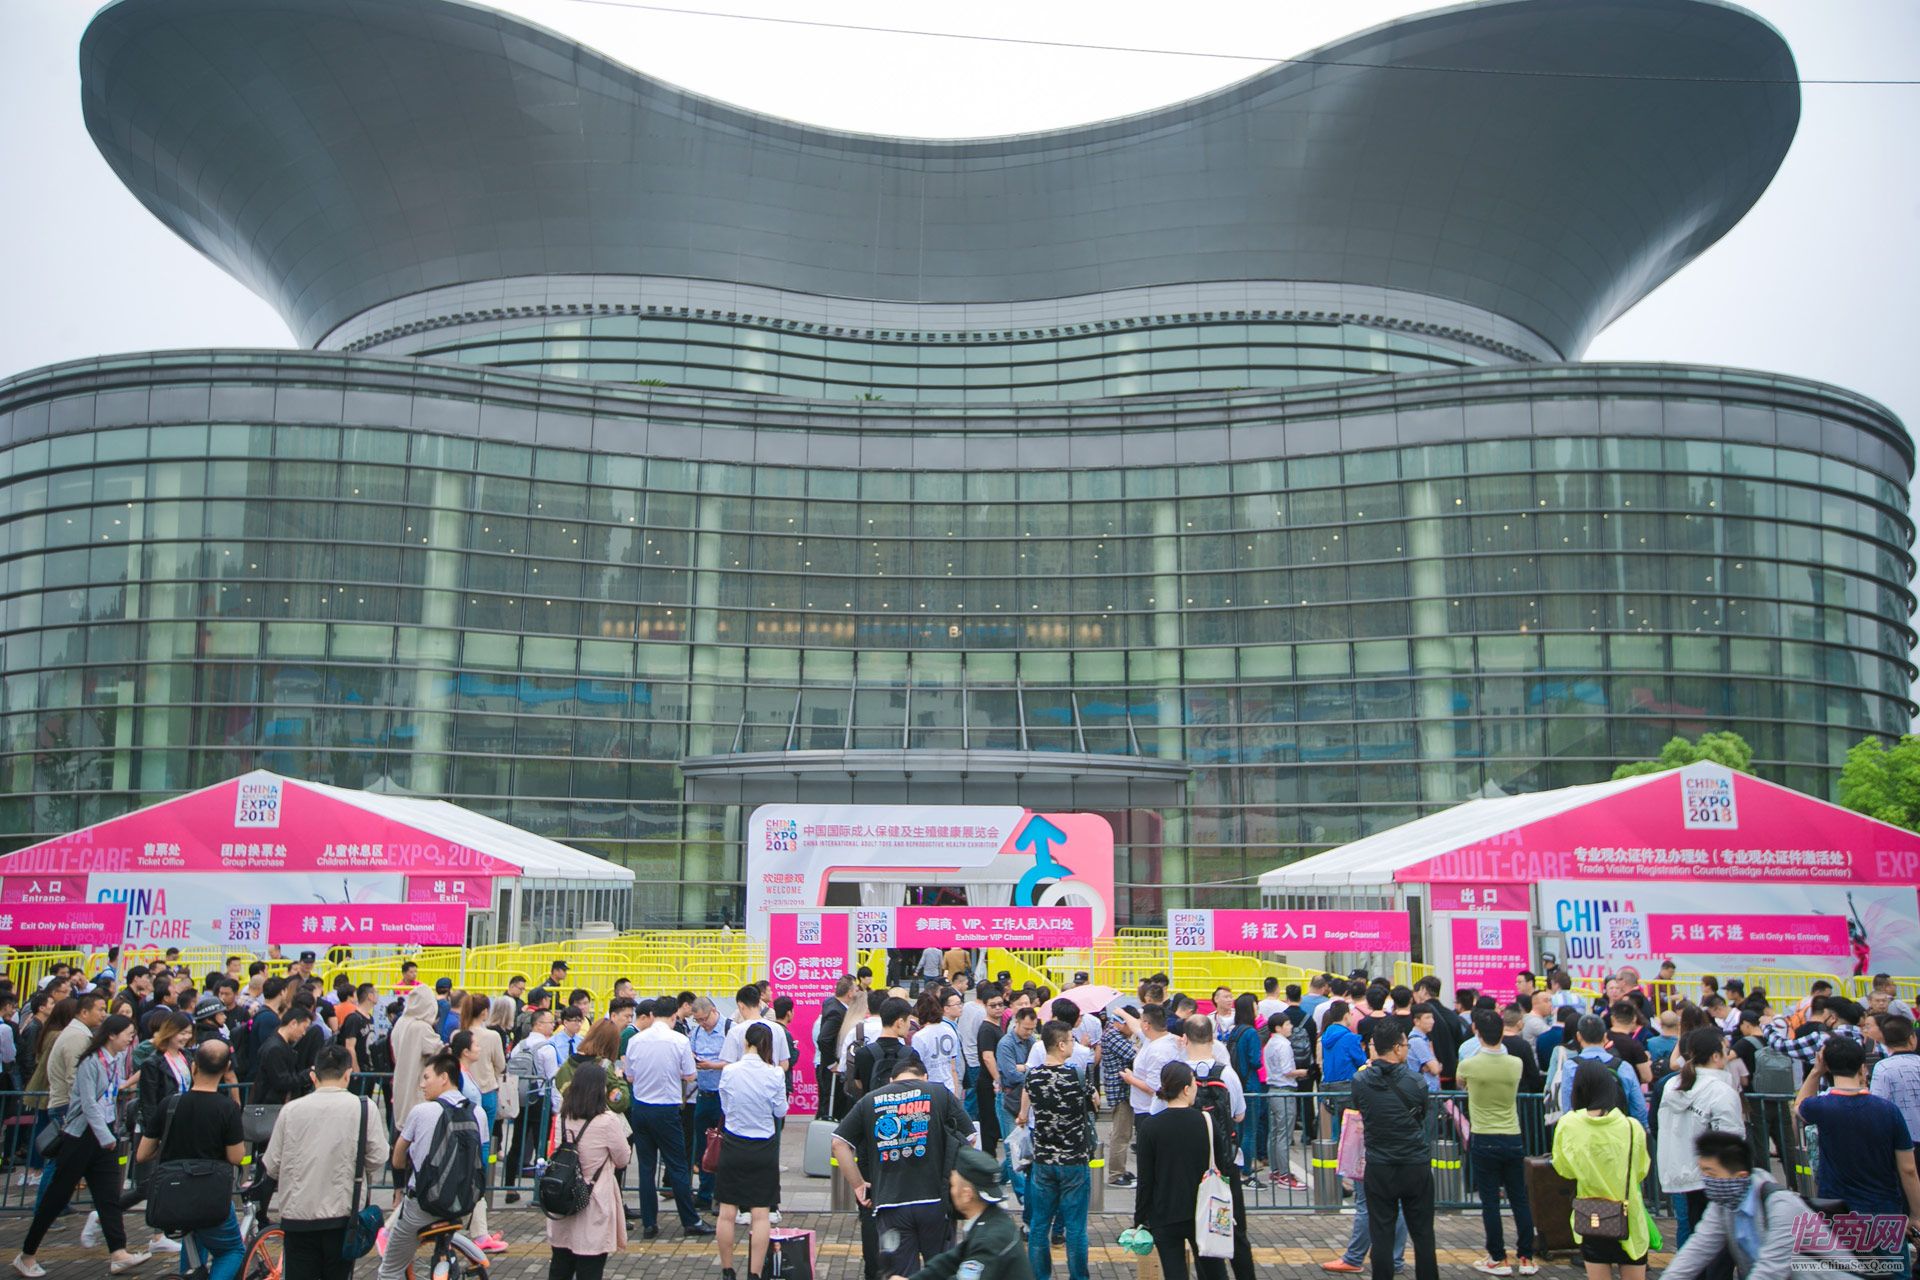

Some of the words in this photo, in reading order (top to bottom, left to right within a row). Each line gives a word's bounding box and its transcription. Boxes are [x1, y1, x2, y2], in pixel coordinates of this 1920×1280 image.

[242, 784, 277, 794] CHINA
[1686, 779, 1729, 789] CHINA
[241, 800, 277, 810] EXPO
[1688, 796, 1730, 808] EXPO
[239, 809, 275, 822] 2018
[1689, 808, 1732, 823] 2018
[765, 818, 797, 828] CHINA
[765, 831, 798, 841] EXPO
[144, 843, 181, 857] 售票处
[221, 844, 288, 858] 团购换票处
[323, 844, 384, 858] 儿童休息区
[765, 840, 797, 852] 2018
[5, 848, 133, 873] ADULT-CARE
[137, 857, 160, 866] Ticket
[161, 857, 185, 866] Office
[221, 857, 247, 868] Group
[248, 857, 285, 867] Purchase
[316, 857, 349, 867] Children
[350, 857, 370, 867] Rest
[370, 857, 389, 867] Area
[1429, 850, 1575, 881] ADULT-CARE
[1578, 863, 1604, 875] Trade
[1606, 864, 1634, 876] Visitor
[1636, 864, 1691, 877] Registration
[1763, 867, 1809, 878] Activation
[1809, 867, 1852, 879] Counter)
[763, 873, 805, 884] 欢迎参观
[28, 880, 62, 894] 入口
[433, 880, 465, 894] 出口
[766, 886, 802, 894] WELCOME
[22, 894, 66, 903] Entrance
[439, 894, 459, 903] Exit
[1460, 888, 1498, 904] 出口
[230, 908, 261, 917] CHINA
[857, 911, 887, 920] CHINA
[1174, 914, 1205, 922] CHINA
[20, 921, 36, 930] Exit
[37, 921, 57, 932] Only
[58, 922, 70, 930] No
[71, 921, 105, 932] Entering
[229, 920, 261, 930] EXPO
[302, 916, 374, 933] 持票入口
[1608, 917, 1640, 926] CHINA
[126, 919, 192, 940] LT-CARE
[381, 923, 404, 932] Ticket
[404, 923, 435, 932] Channel
[857, 924, 888, 933] EXPO
[1175, 927, 1205, 936] EXPO
[1241, 922, 1317, 940] 持证入口
[1670, 924, 1744, 941] 只出不进
[228, 930, 260, 941] 2018
[857, 933, 887, 943] 2018
[955, 933, 989, 942] Exhibitor
[990, 933, 1003, 942] VIP
[1003, 933, 1035, 942] Channel
[1324, 930, 1349, 940] Badge
[1349, 930, 1380, 939] Channel
[1609, 930, 1640, 939] EXPO
[1749, 932, 1765, 941] Exit
[1766, 932, 1784, 942] Only
[1784, 932, 1796, 941] No
[1796, 932, 1830, 943] Entering
[1175, 935, 1206, 946] 2018
[1610, 939, 1642, 950] 2018
[798, 957, 844, 968] 未满18岁
[776, 962, 794, 977] 18
[775, 983, 799, 991] People
[873, 1089, 922, 1105] WISSEND
[897, 1100, 931, 1115] AQUA
